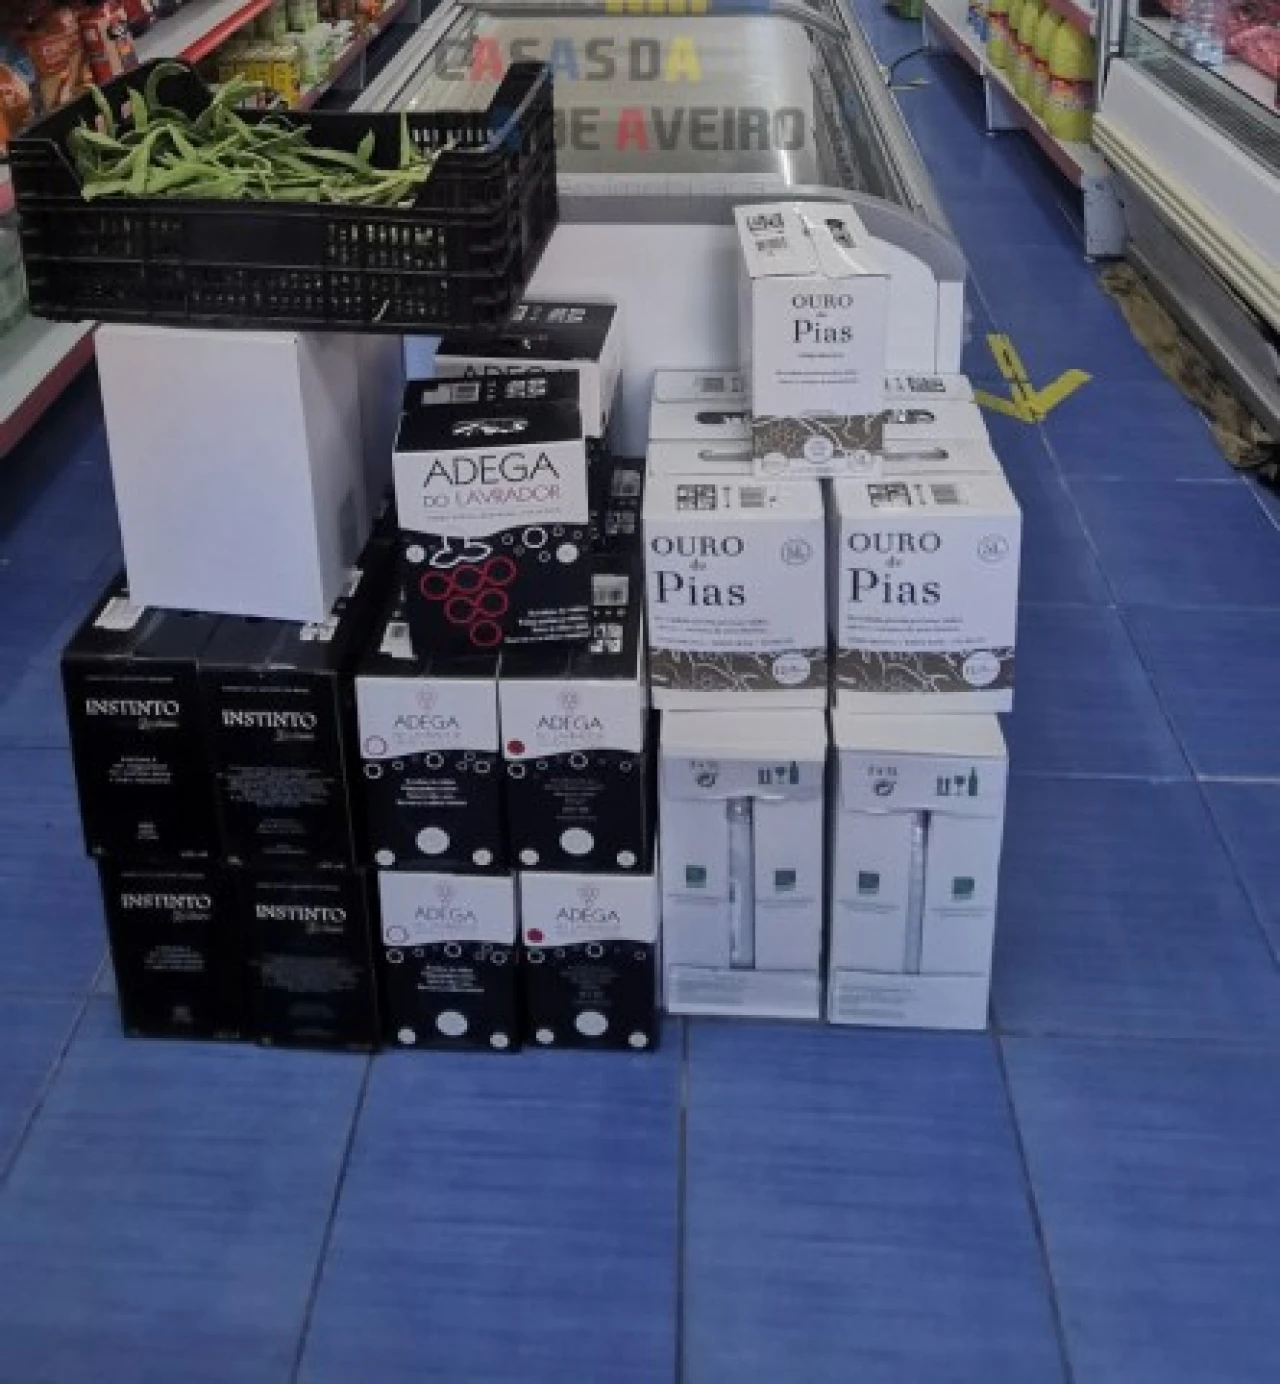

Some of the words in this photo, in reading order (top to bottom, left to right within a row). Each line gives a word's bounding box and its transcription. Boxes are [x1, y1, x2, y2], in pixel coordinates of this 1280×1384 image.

[792, 293, 853, 309] OURO
[792, 319, 853, 344] Pias
[423, 452, 560, 488] ADEGA
[424, 495, 450, 509] DO
[455, 484, 560, 505] LAVRADOR
[651, 535, 745, 557] OURO
[848, 531, 942, 554] OURO
[653, 570, 746, 606] Pias
[848, 567, 941, 605] Pias
[85, 699, 180, 716] INSTINTO
[221, 709, 318, 729] INSTINTO
[394, 715, 460, 730] ADEGA
[536, 715, 603, 731] ADEGA
[120, 894, 212, 910] INSTINTO
[255, 904, 347, 924] INSTINTO
[414, 906, 478, 923] ADEGA
[556, 906, 621, 924] ADEGA
